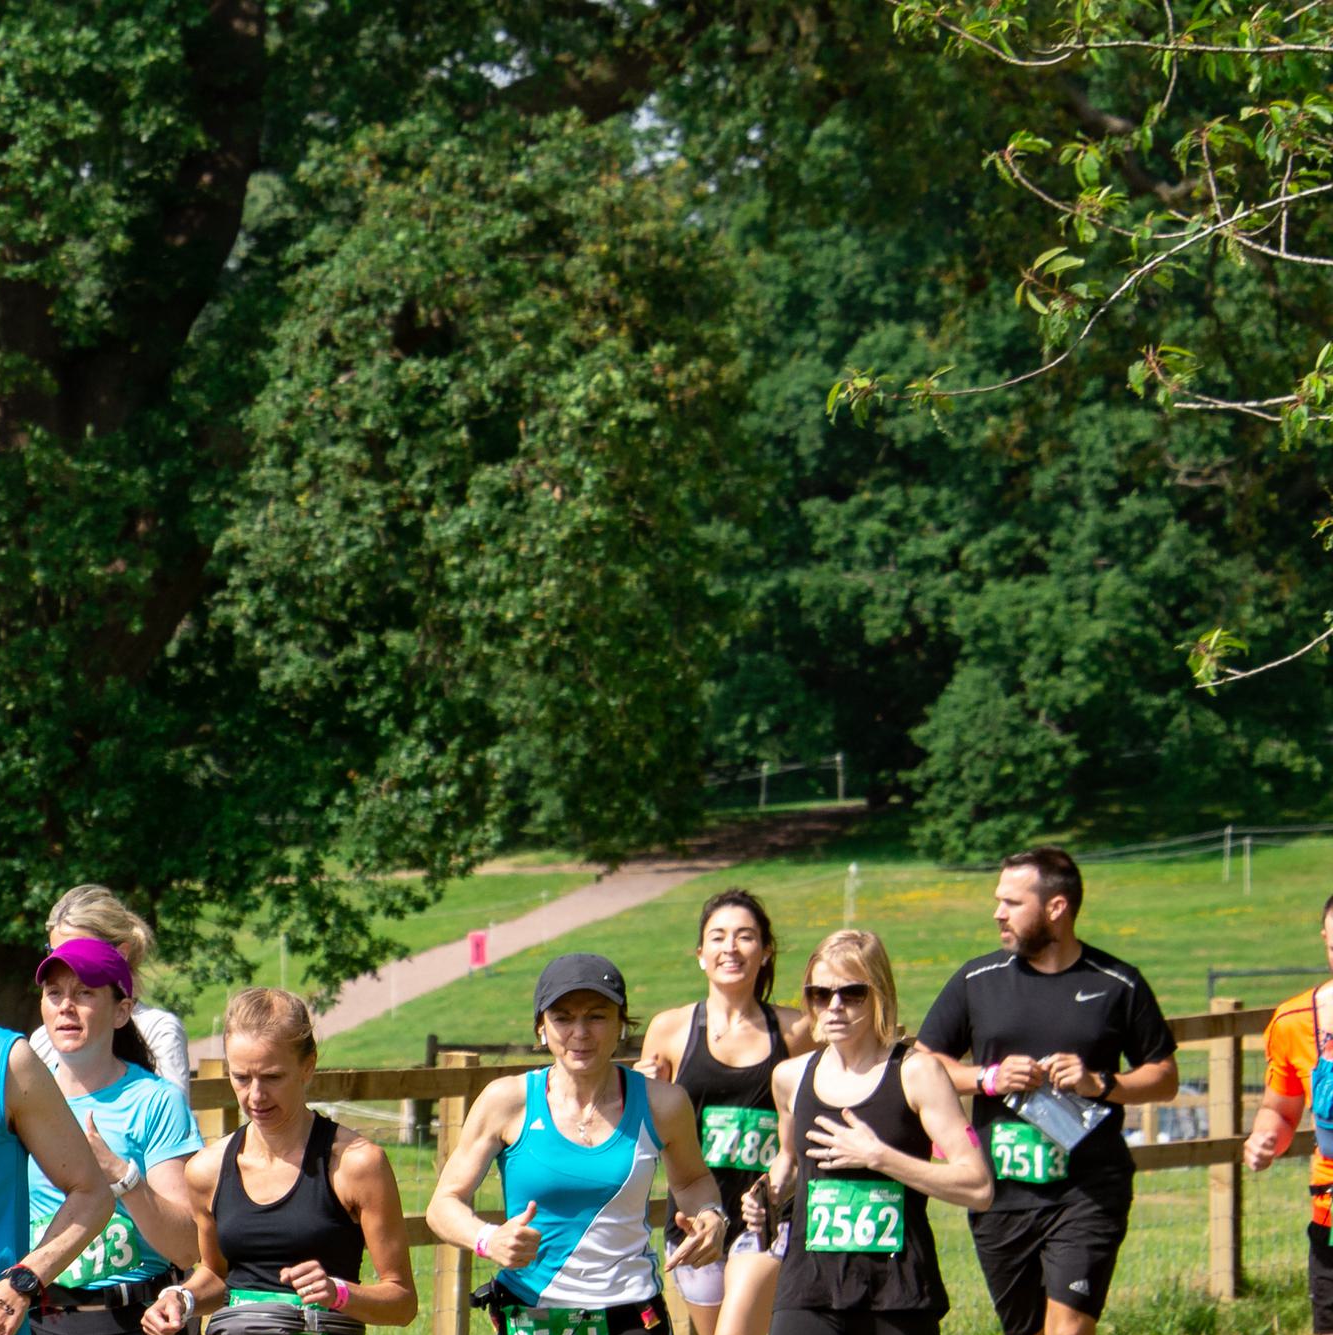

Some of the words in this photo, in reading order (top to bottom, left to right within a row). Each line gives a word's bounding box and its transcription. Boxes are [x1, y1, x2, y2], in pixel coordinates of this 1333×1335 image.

[704, 1128, 776, 1167] 2486
[995, 1144, 1065, 1178] 2513
[811, 1206, 899, 1246] 2562
